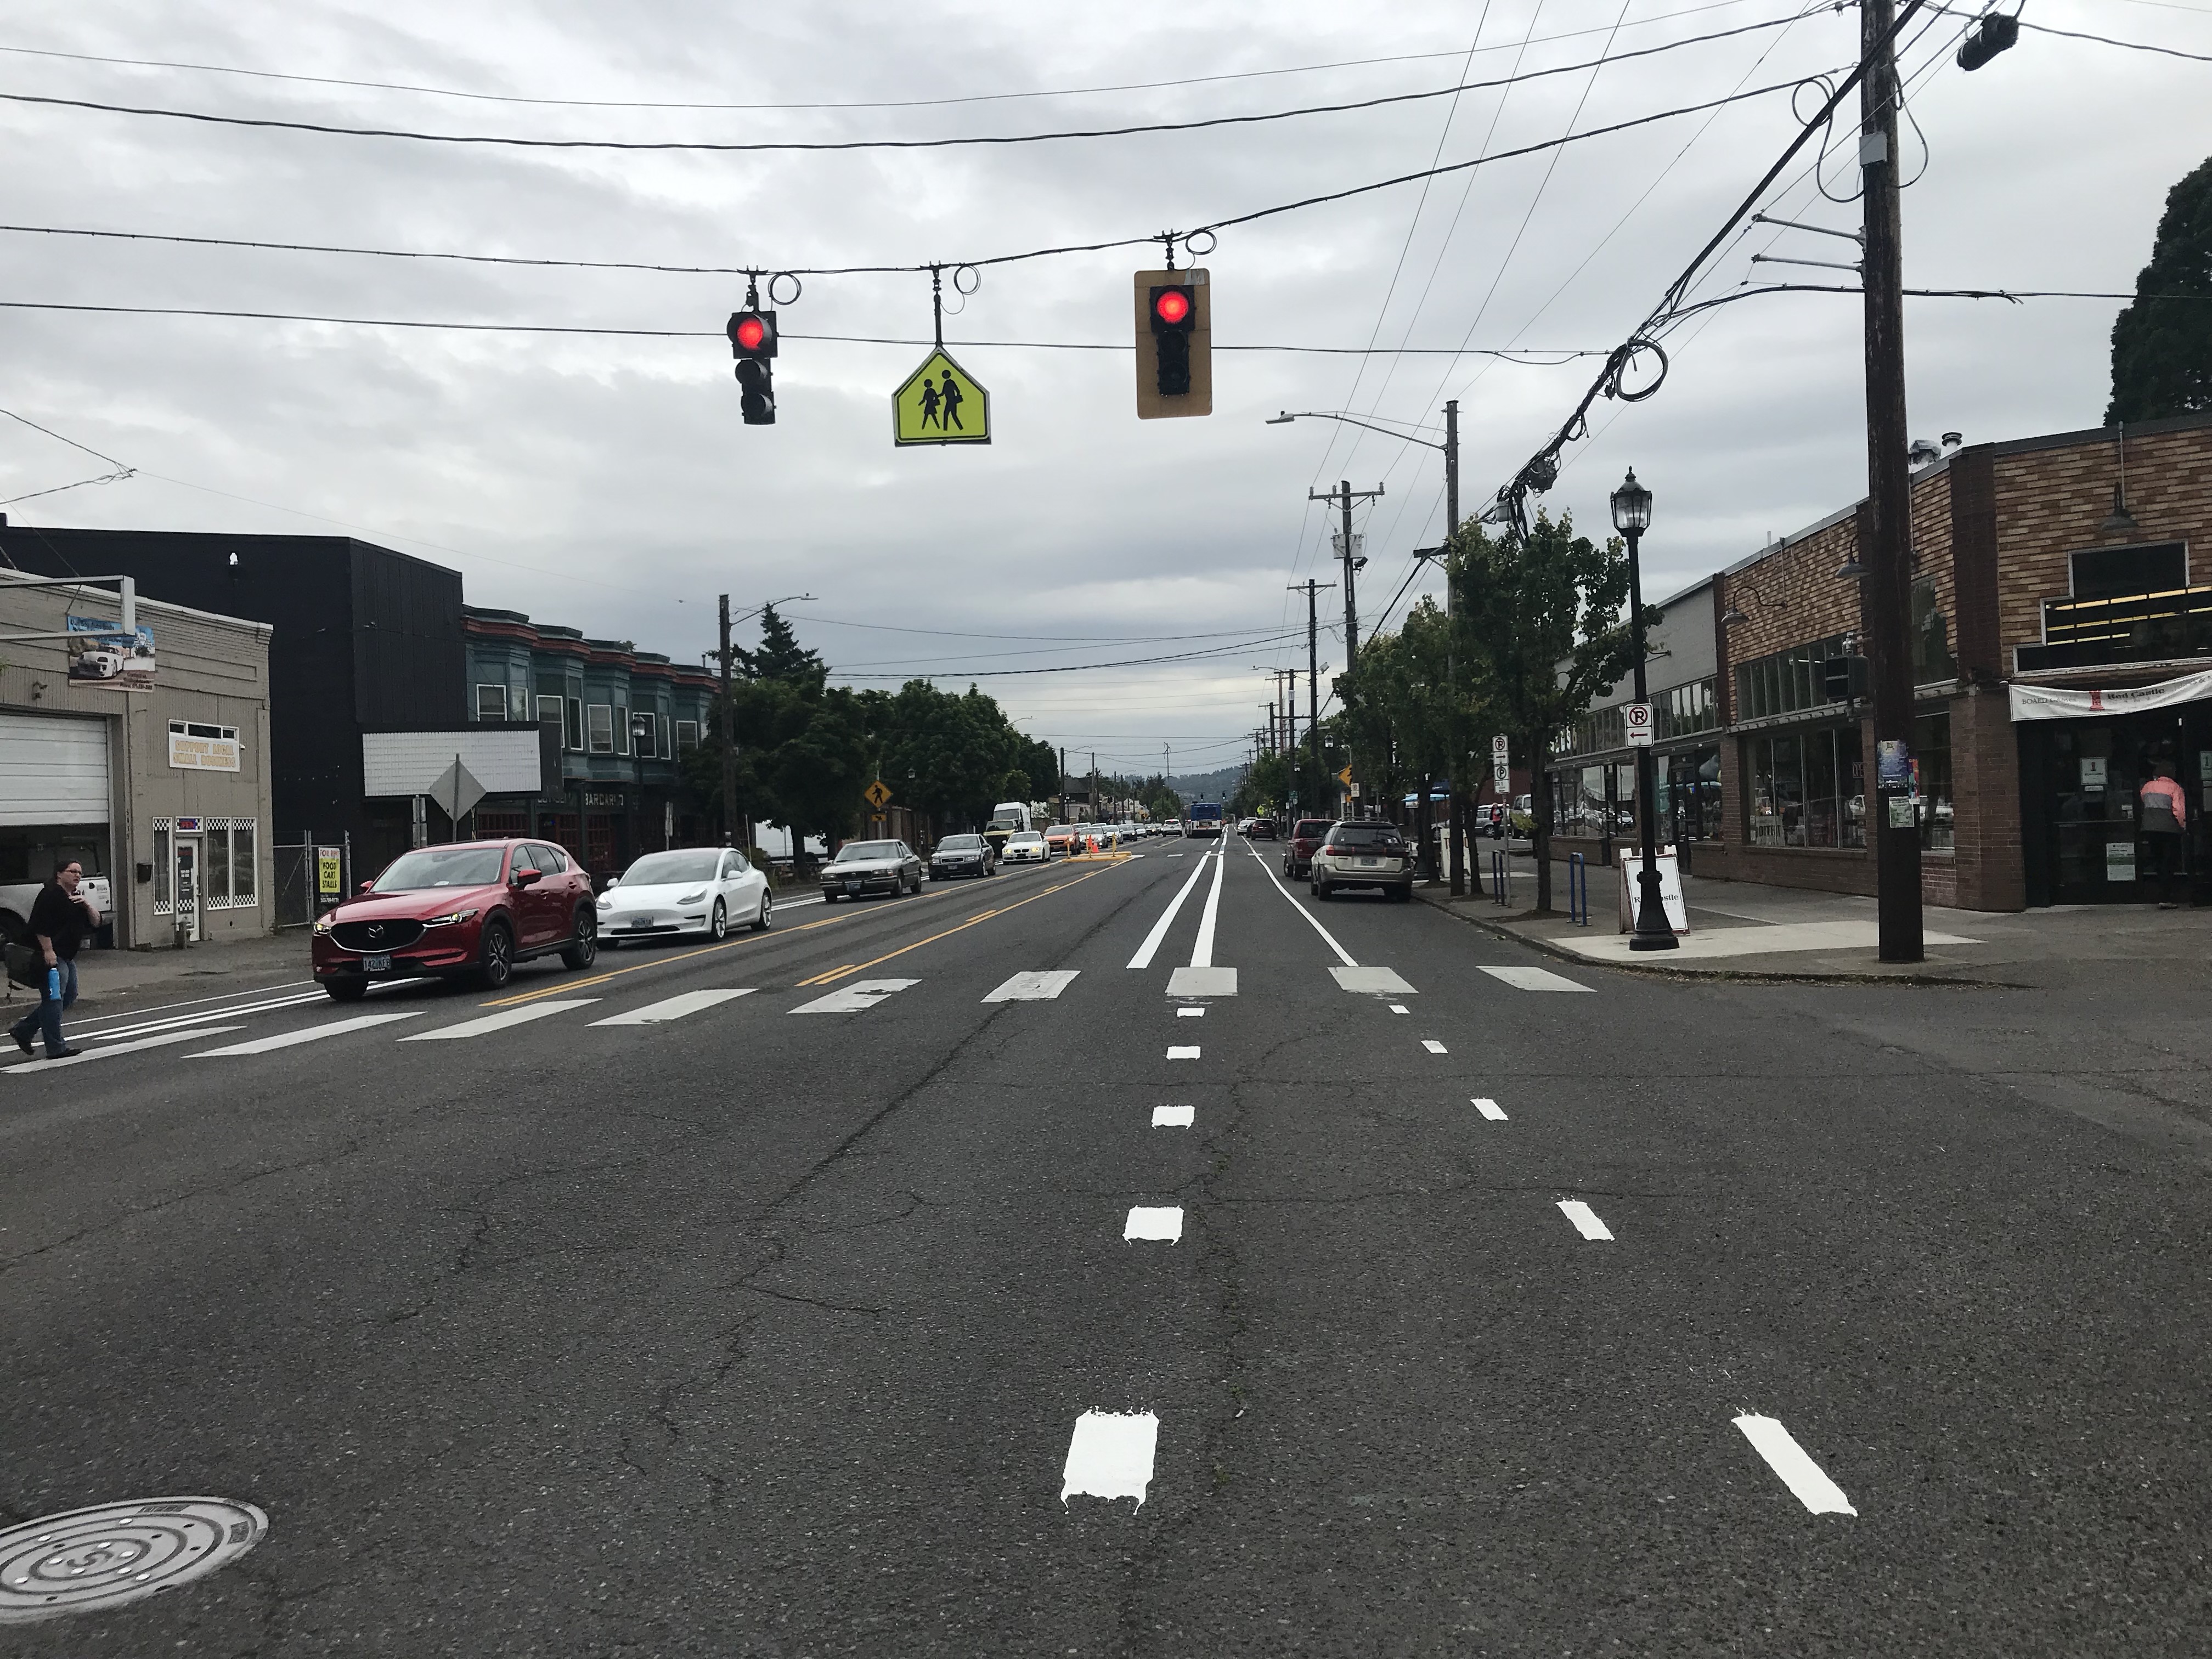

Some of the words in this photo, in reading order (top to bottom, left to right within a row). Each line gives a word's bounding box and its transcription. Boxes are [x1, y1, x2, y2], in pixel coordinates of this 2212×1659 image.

[175, 740, 209, 754] SUPPORT
[212, 743, 234, 756] LOCAL
[173, 752, 197, 765] SMALL
[201, 755, 236, 768] BUSINESS
[323, 861, 337, 871] FOOD
[324, 871, 336, 879] CART
[322, 879, 337, 889] STALLS
